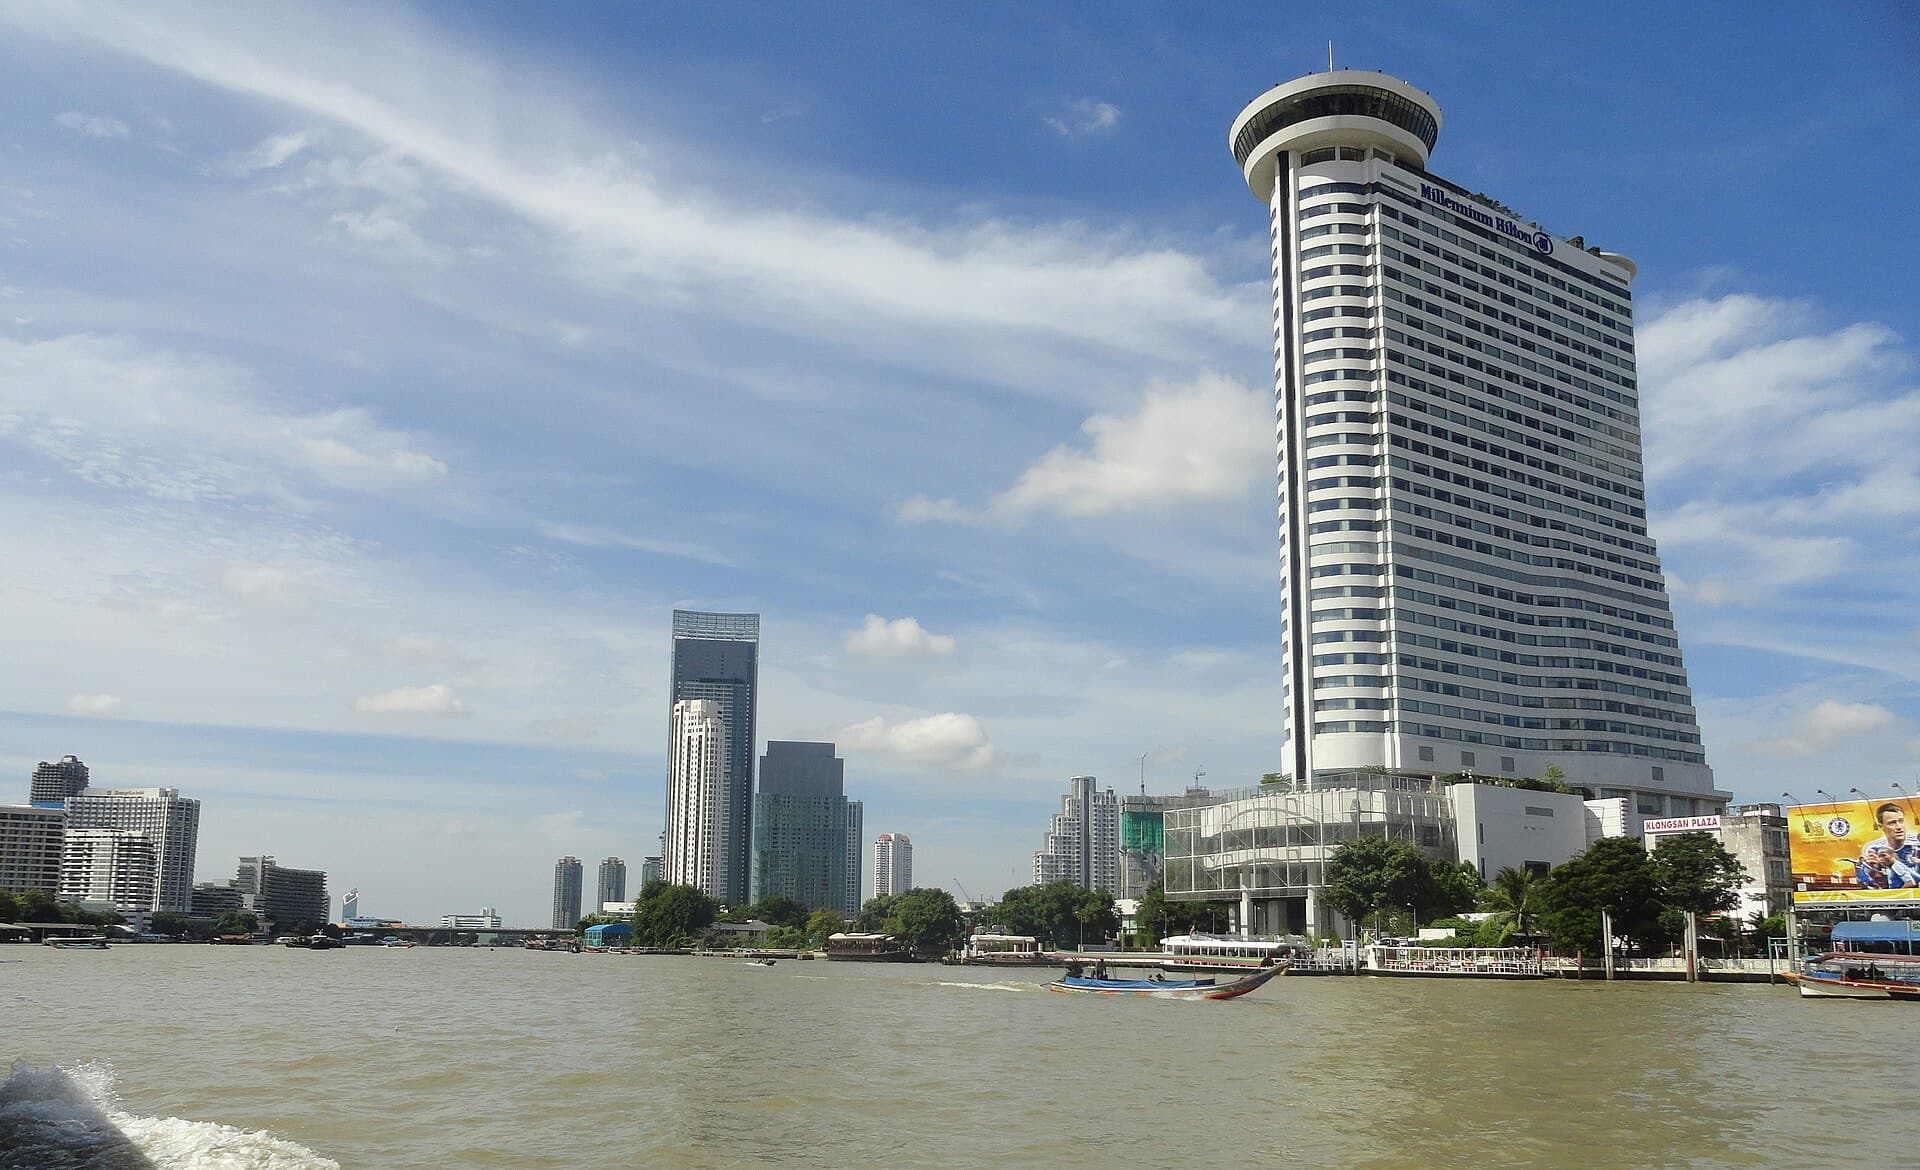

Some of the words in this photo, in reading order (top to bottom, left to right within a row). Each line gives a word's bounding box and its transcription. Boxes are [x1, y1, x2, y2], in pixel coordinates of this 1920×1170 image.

[1420, 183, 1493, 227] Millennium
[1495, 216, 1532, 244] Hilton
[1645, 819, 1689, 830] KLONGSAN
[1692, 817, 1718, 827] PLAZA
